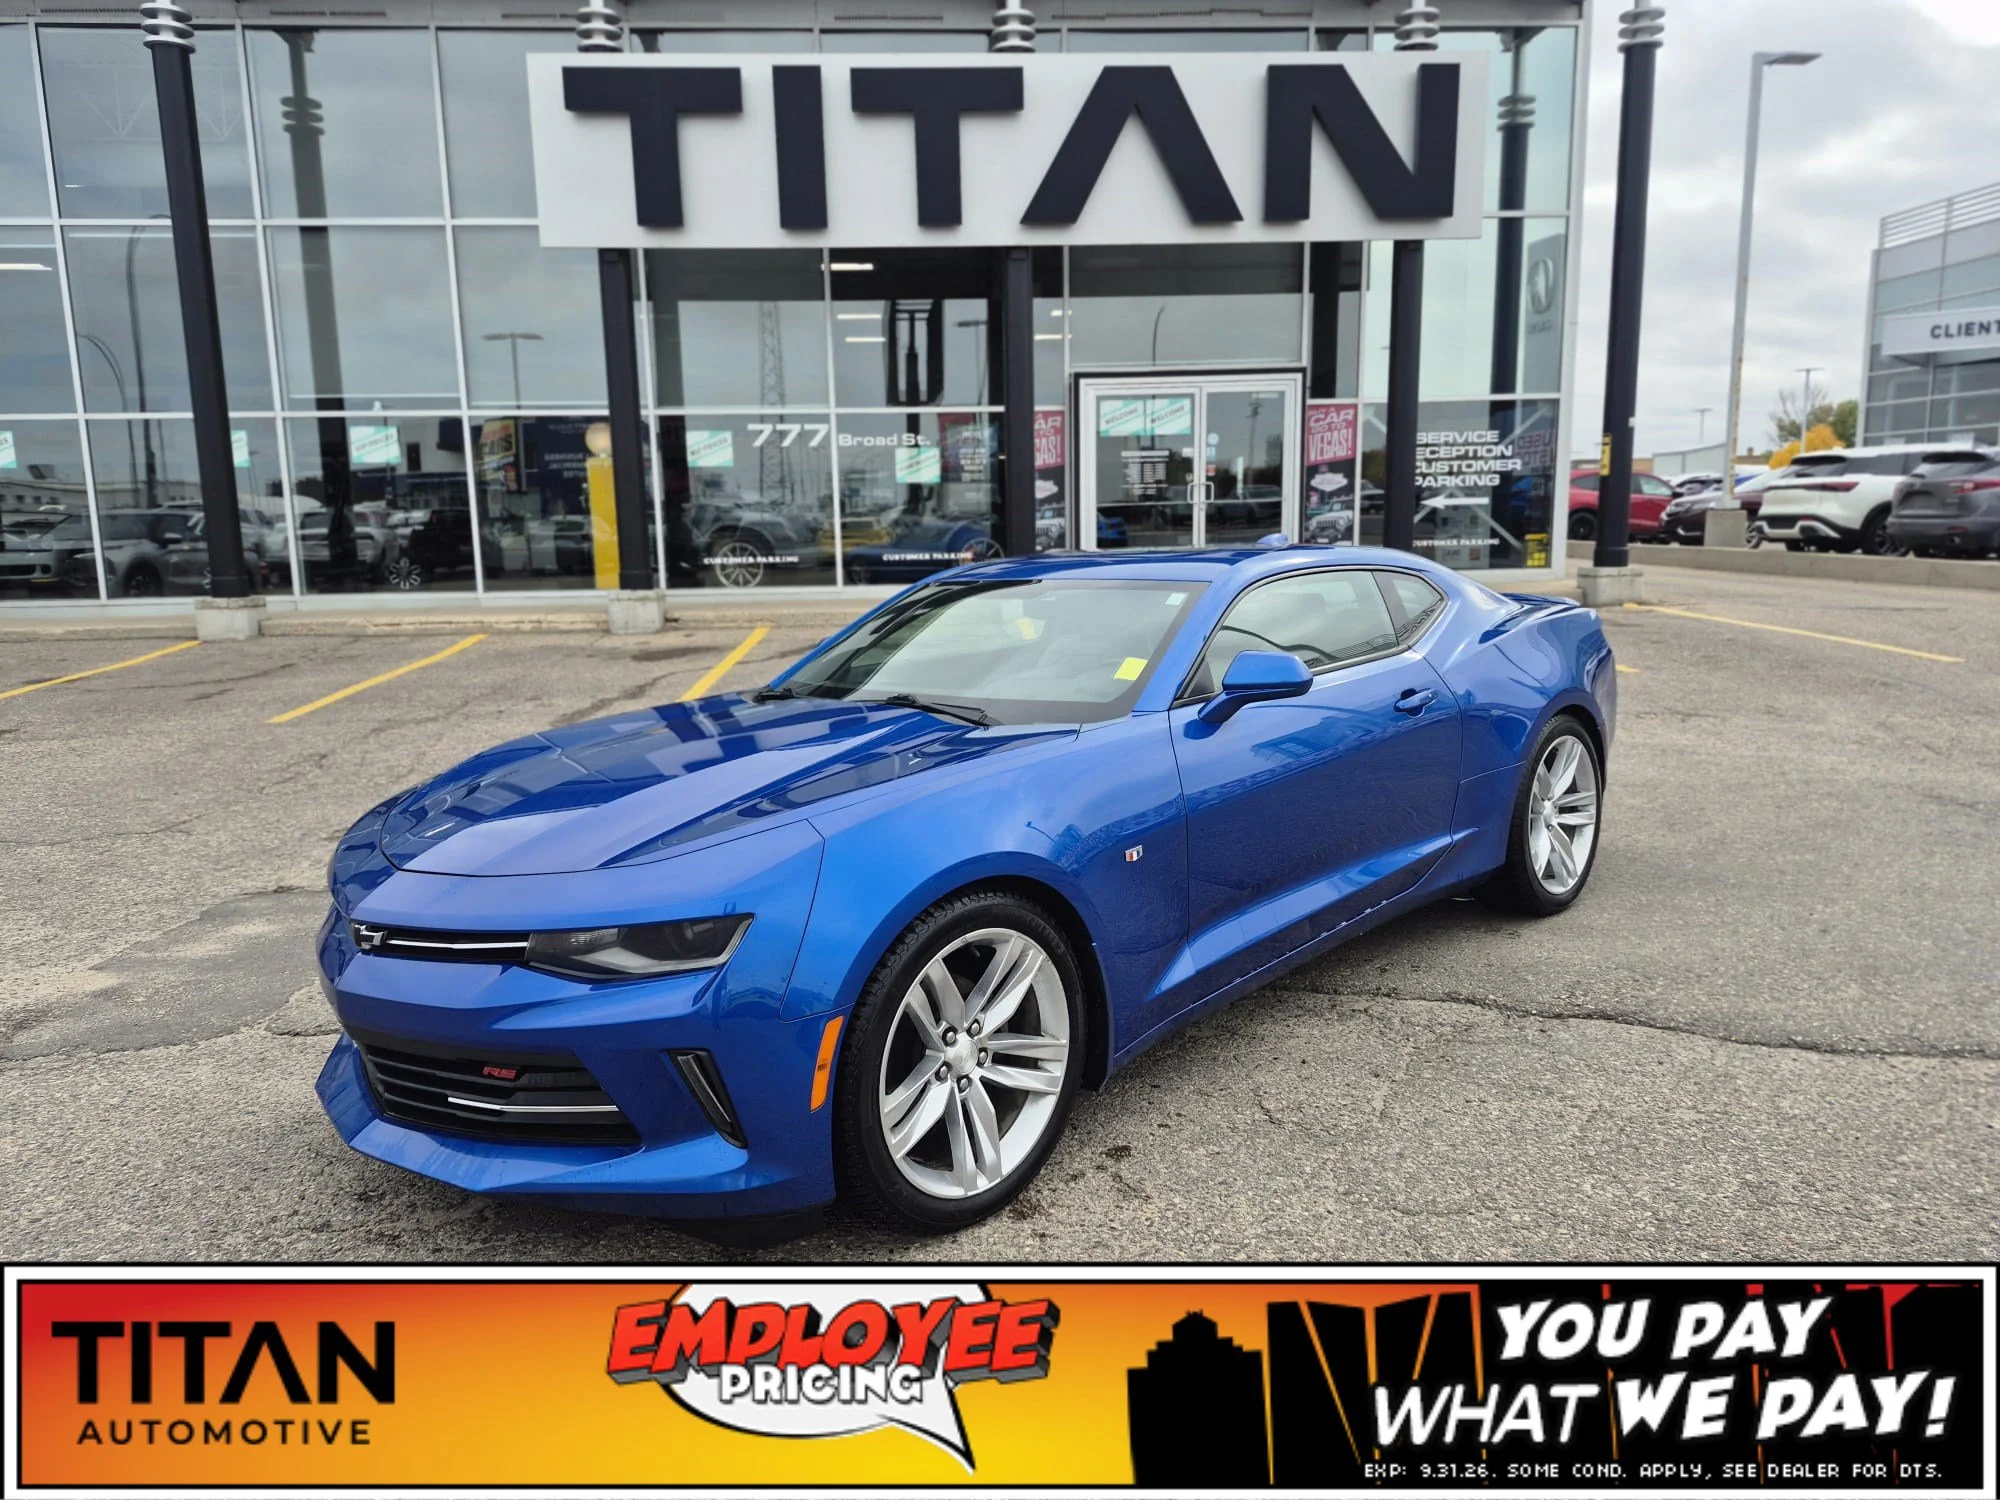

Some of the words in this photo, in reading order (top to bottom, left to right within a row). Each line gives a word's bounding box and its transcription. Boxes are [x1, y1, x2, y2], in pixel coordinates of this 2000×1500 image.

[562, 62, 1461, 230] TITAN
[1104, 407, 1138, 425] WELCOME
[1150, 404, 1185, 425] WELCOME
[1310, 409, 1354, 427] CAR
[746, 423, 829, 448] 777
[838, 433, 898, 446] Broad
[901, 433, 931, 446] St.
[1416, 430, 1500, 445] SERVICE
[1309, 427, 1353, 462] VEGAS!
[1415, 444, 1512, 459] ECEPTION
[1459, 537, 1500, 546] PARKING
[704, 556, 753, 565] CUSTOMER
[756, 555, 799, 564] PARKING
[882, 552, 930, 561] CUSTOMER
[932, 551, 974, 560] PARKING
[483, 1065, 517, 1079] RS
